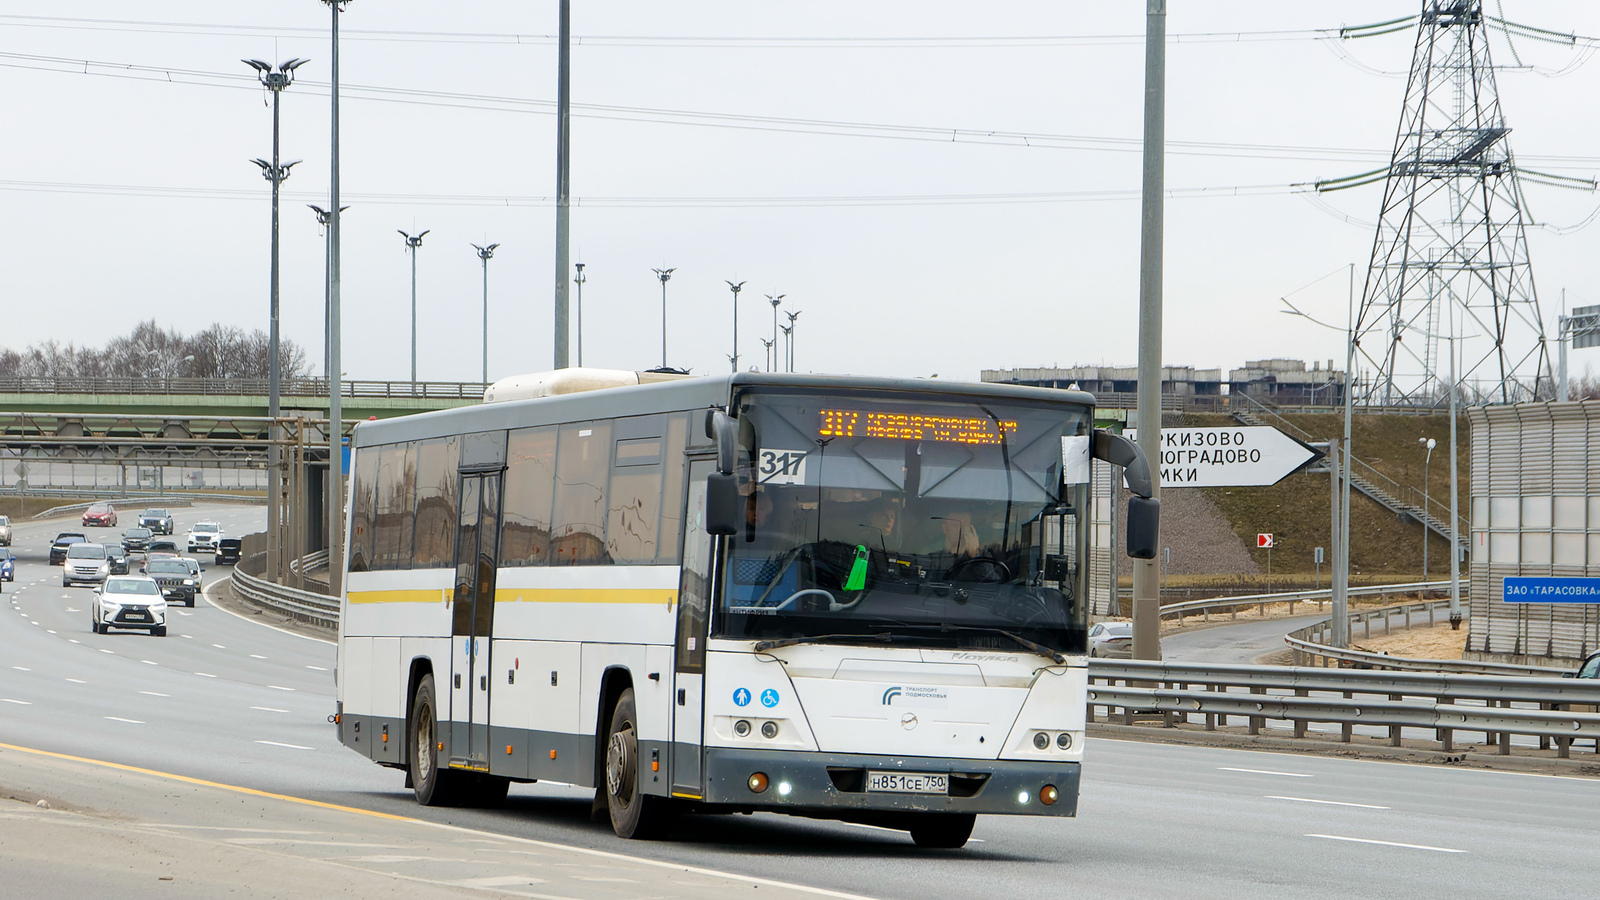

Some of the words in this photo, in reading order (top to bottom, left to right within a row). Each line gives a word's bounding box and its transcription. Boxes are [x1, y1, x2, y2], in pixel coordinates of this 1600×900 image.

[819, 410, 858, 437] 317
[1129, 432, 1244, 446] ЧКИЗОВО
[760, 451, 806, 476] 317
[1160, 449, 1261, 465] ОГРАДОВО
[1160, 468, 1197, 482] МКИ
[1507, 585, 1528, 595] ЗАО
[872, 775, 922, 790] Н851СЕ
